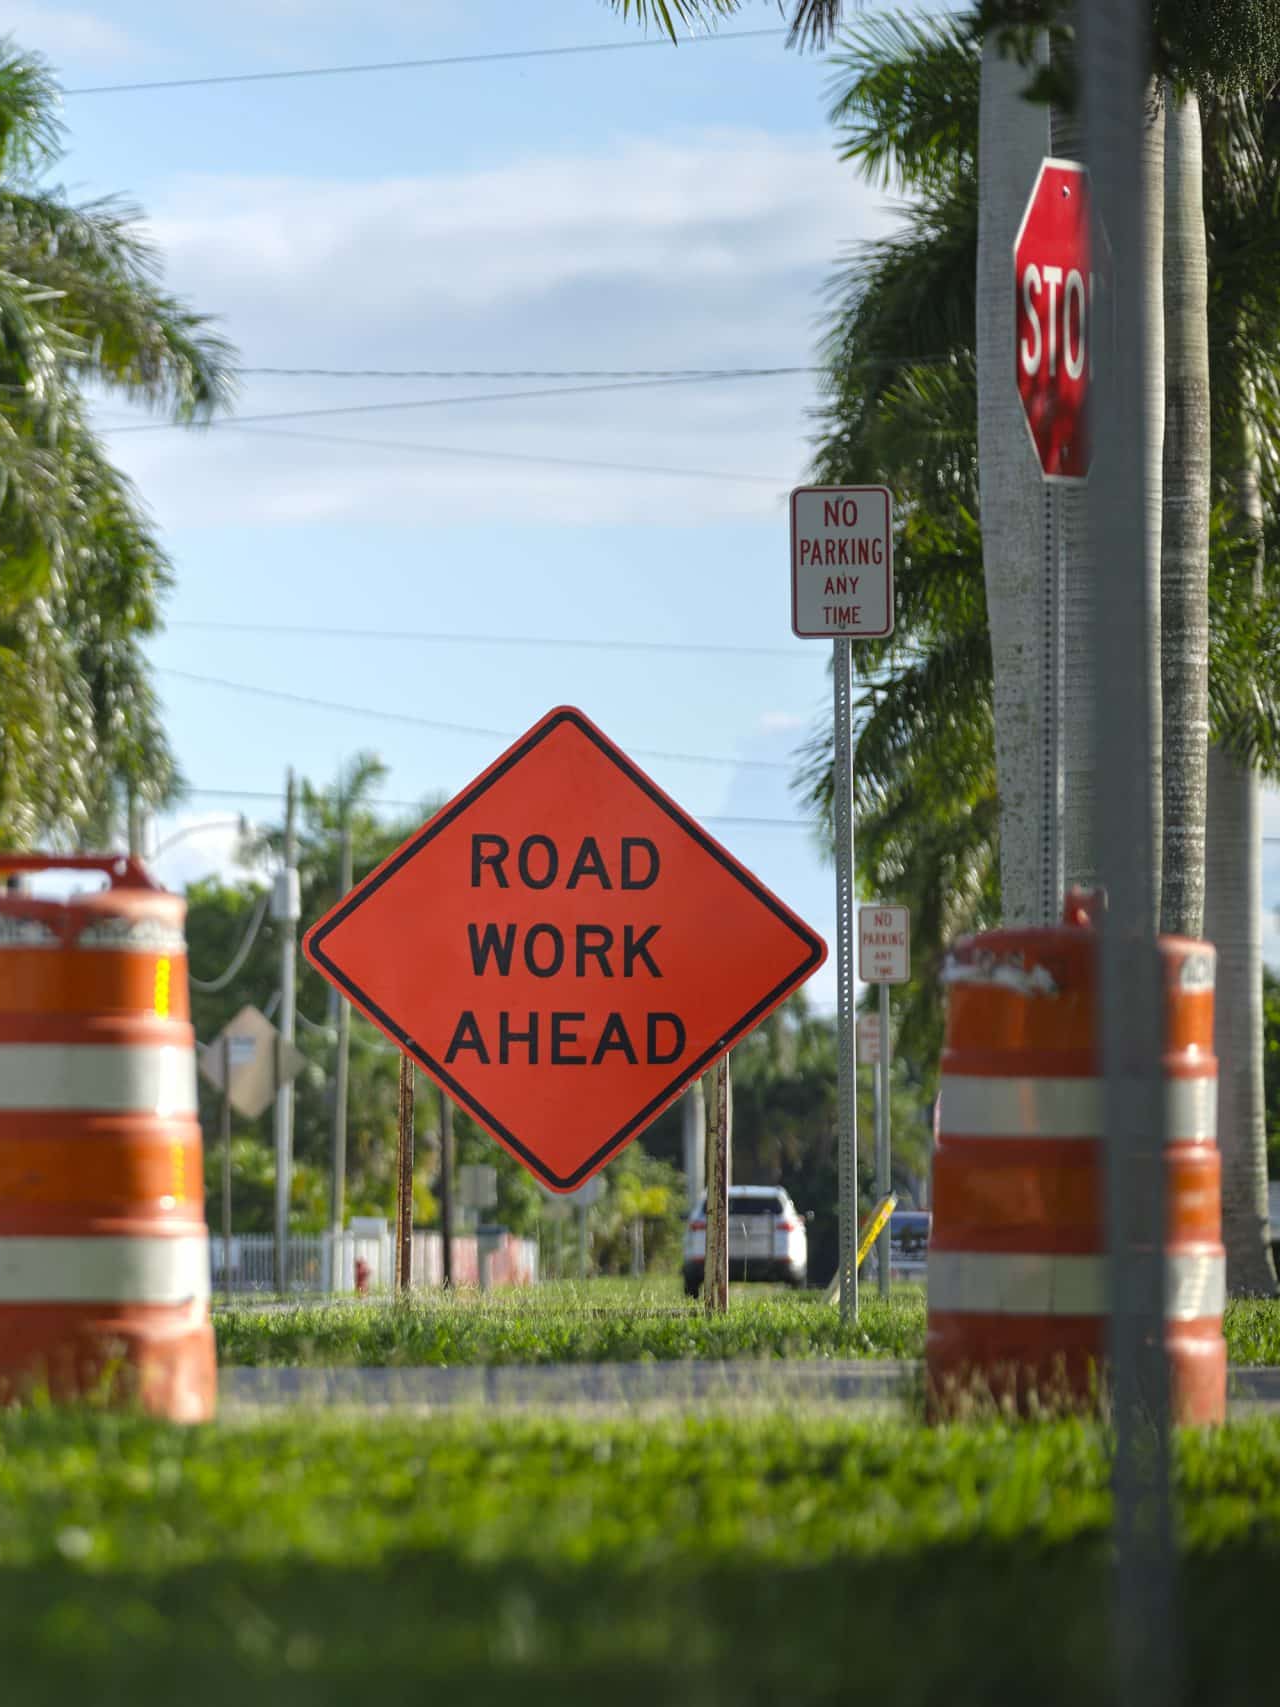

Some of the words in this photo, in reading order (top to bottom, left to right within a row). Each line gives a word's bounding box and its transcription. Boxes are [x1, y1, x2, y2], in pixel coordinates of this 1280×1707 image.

[1021, 263, 1094, 380] STO
[823, 500, 858, 527] NO
[799, 538, 883, 566] PARKING
[823, 576, 860, 595] ANY
[823, 606, 862, 625] TIME
[470, 833, 661, 891] ROAD
[873, 912, 892, 927] NO
[467, 922, 664, 979] WORK
[443, 1010, 688, 1067] AHEAD
